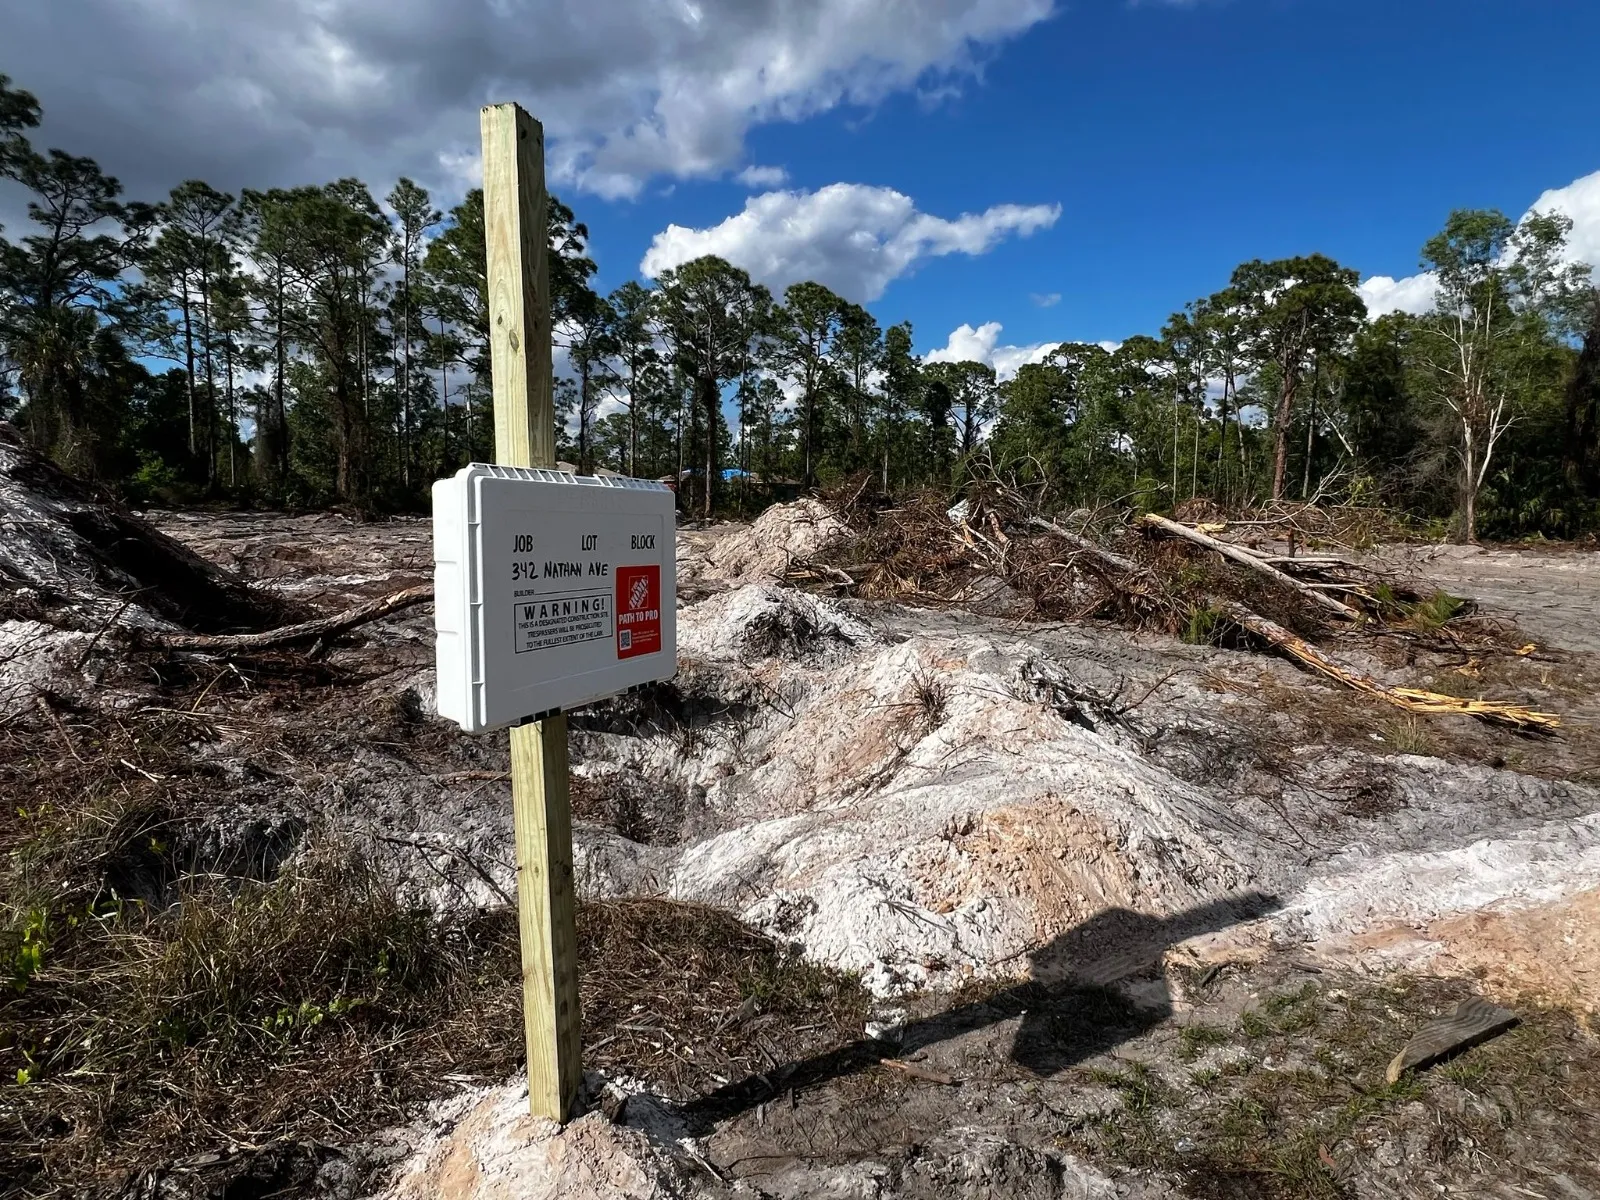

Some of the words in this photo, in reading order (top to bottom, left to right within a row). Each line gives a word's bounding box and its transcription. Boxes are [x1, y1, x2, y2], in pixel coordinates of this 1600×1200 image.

[514, 534, 533, 553] JOB
[581, 534, 597, 551] LOT
[631, 534, 655, 550] BLOCK
[512, 561, 538, 580] 342
[544, 561, 581, 578] NATHAN
[588, 561, 608, 576] AVE
[514, 589, 535, 597] BUILDER
[524, 598, 605, 620] WARNING!
[618, 613, 635, 625] PATH
[635, 611, 644, 622] TO
[644, 609, 659, 621] PRO
[538, 617, 567, 626] DESIGNATED
[567, 613, 600, 622] CONSTRUCTION
[527, 628, 558, 638] TRESPASSERS
[575, 621, 602, 631] PROSECUTED
[526, 641, 533, 649] TO
[543, 637, 562, 645] FULLEST
[562, 633, 579, 642] EXTENT
